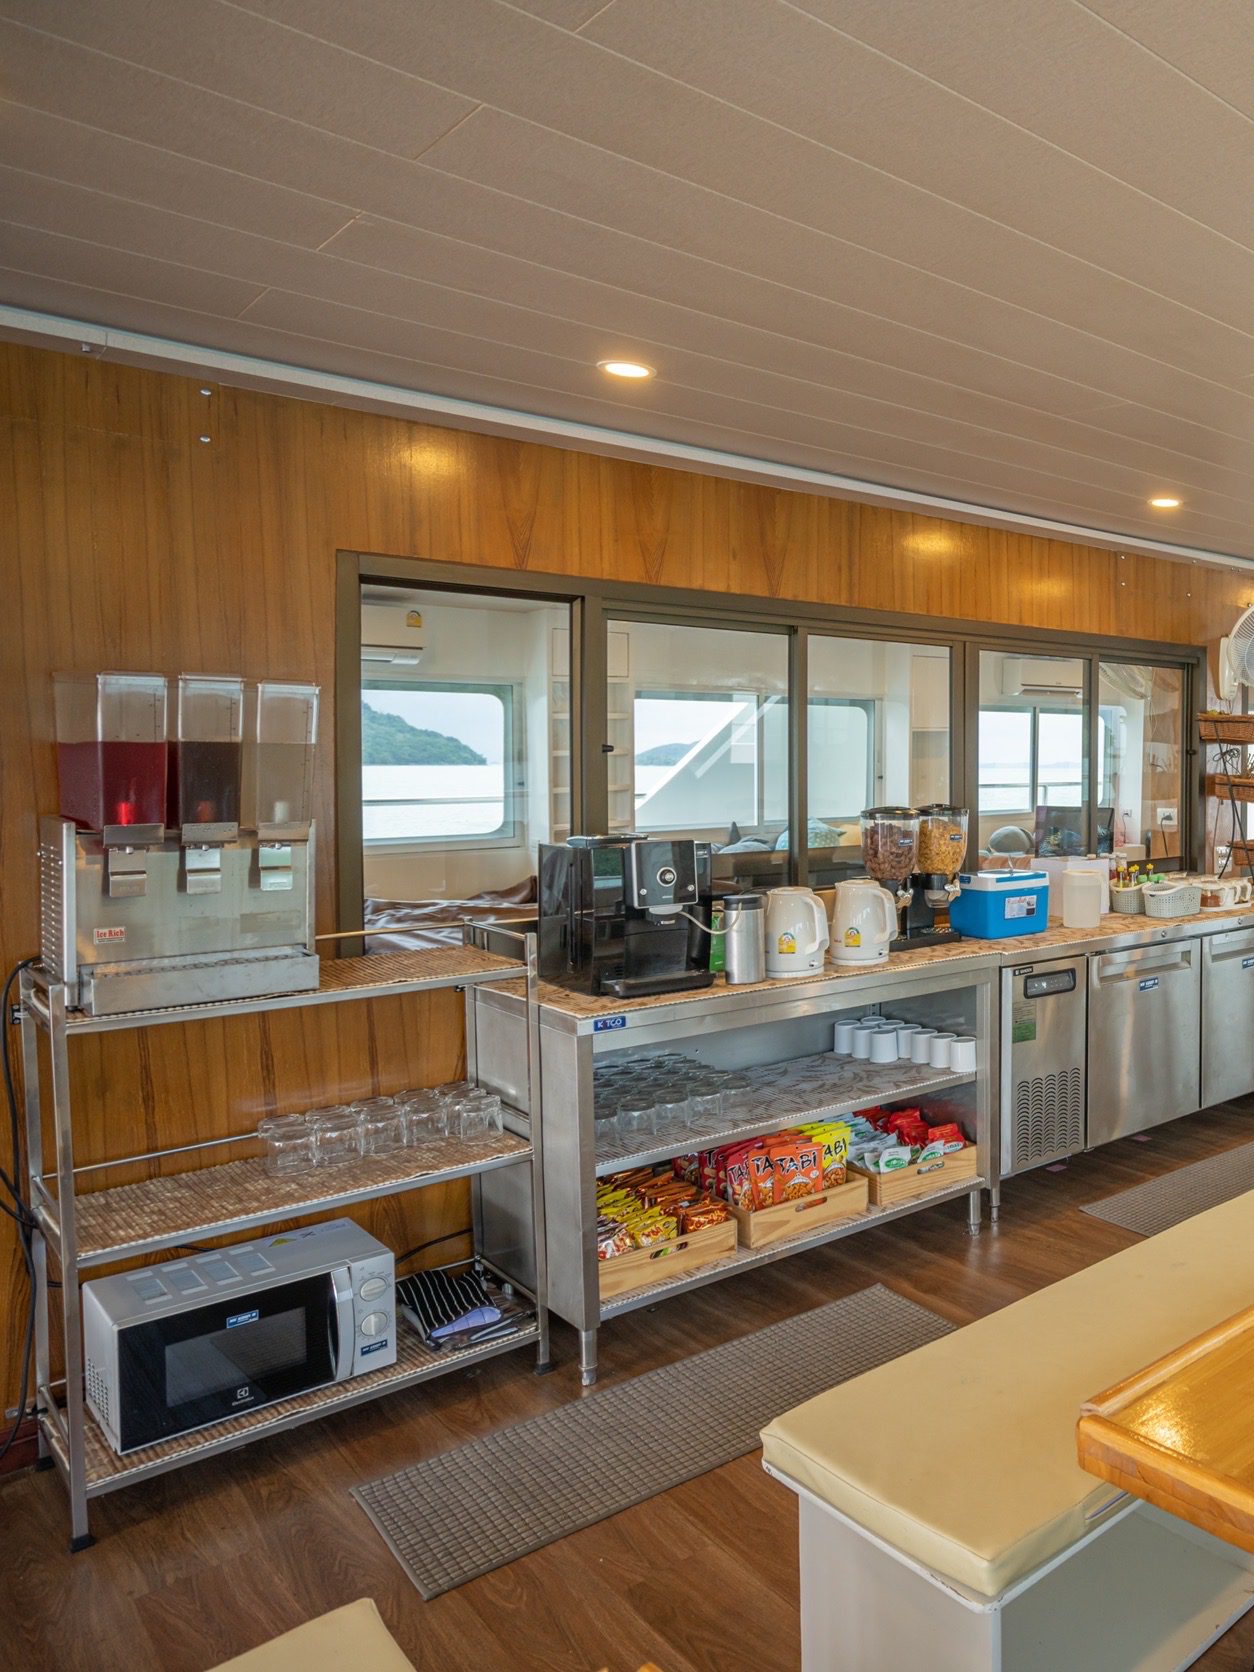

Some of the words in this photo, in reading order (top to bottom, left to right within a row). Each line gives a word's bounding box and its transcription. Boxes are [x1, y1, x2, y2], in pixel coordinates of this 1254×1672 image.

[96, 930, 107, 938] Ice
[108, 929, 125, 938] Rich
[752, 1156, 774, 1176] TA
[775, 1151, 817, 1174] TABI
